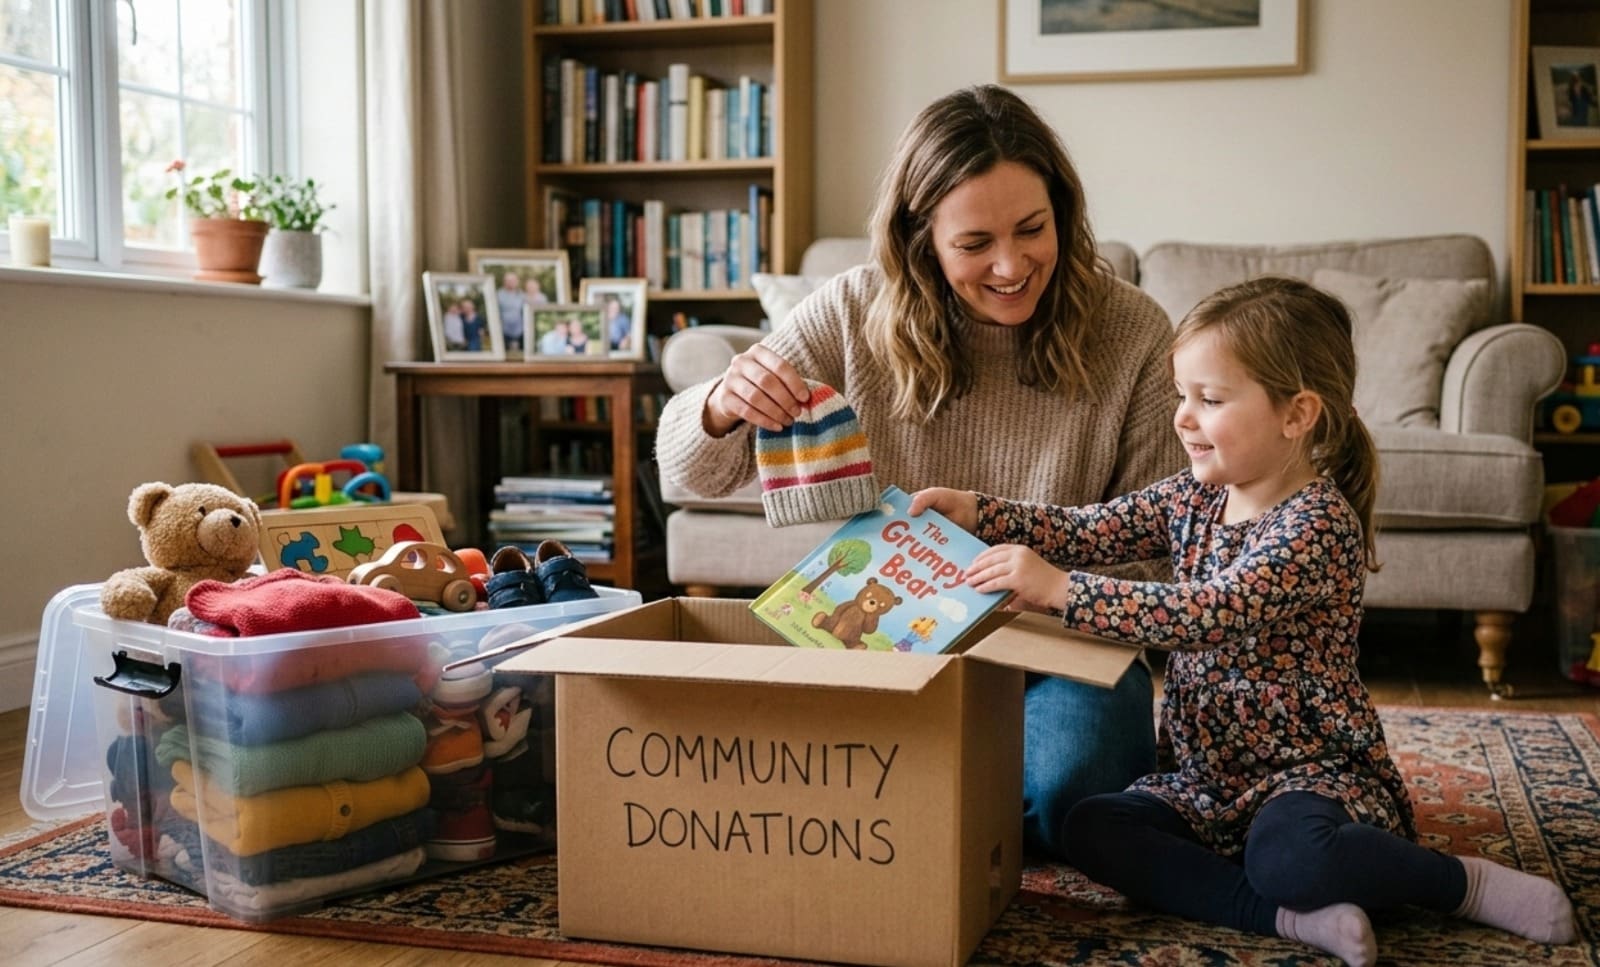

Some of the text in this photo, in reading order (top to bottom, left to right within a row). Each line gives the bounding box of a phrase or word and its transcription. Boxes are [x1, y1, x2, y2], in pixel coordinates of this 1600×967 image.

[881, 520, 966, 589] Grumpy
[922, 522, 949, 546] The
[879, 553, 938, 600] Bear
[606, 726, 899, 799] COMMUNITY
[623, 802, 895, 865] DONATIONS
